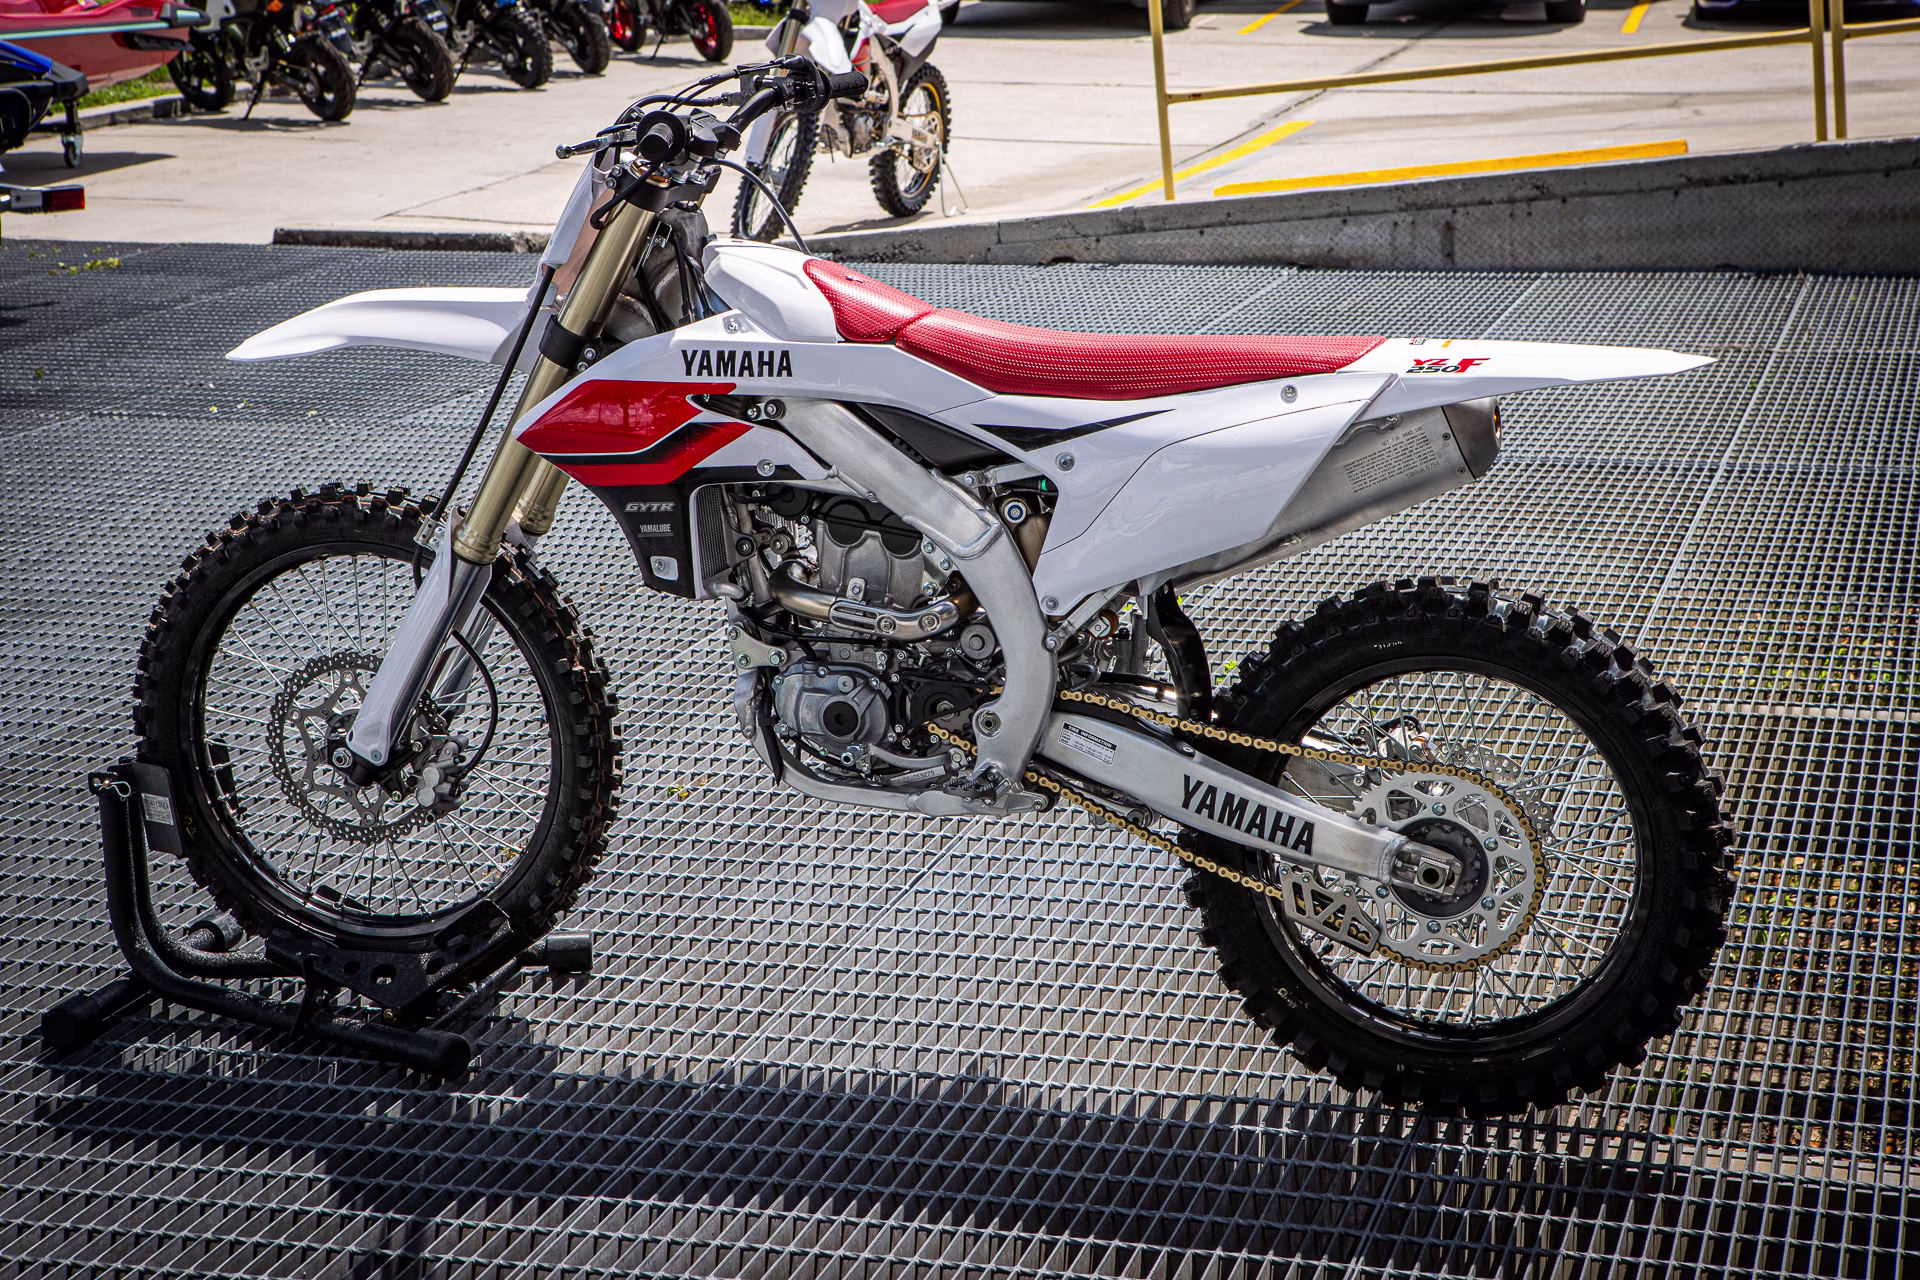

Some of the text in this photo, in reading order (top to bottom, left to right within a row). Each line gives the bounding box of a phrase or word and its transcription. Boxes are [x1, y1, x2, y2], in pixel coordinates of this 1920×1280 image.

[681, 349, 793, 378] YAMAHA
[1412, 358, 1450, 366] YZ
[624, 501, 676, 513] GYTR
[639, 524, 672, 533] YAMALUBE
[1068, 725, 1113, 748] TIRE INFORMATION
[1181, 773, 1316, 857] YAMAHA
